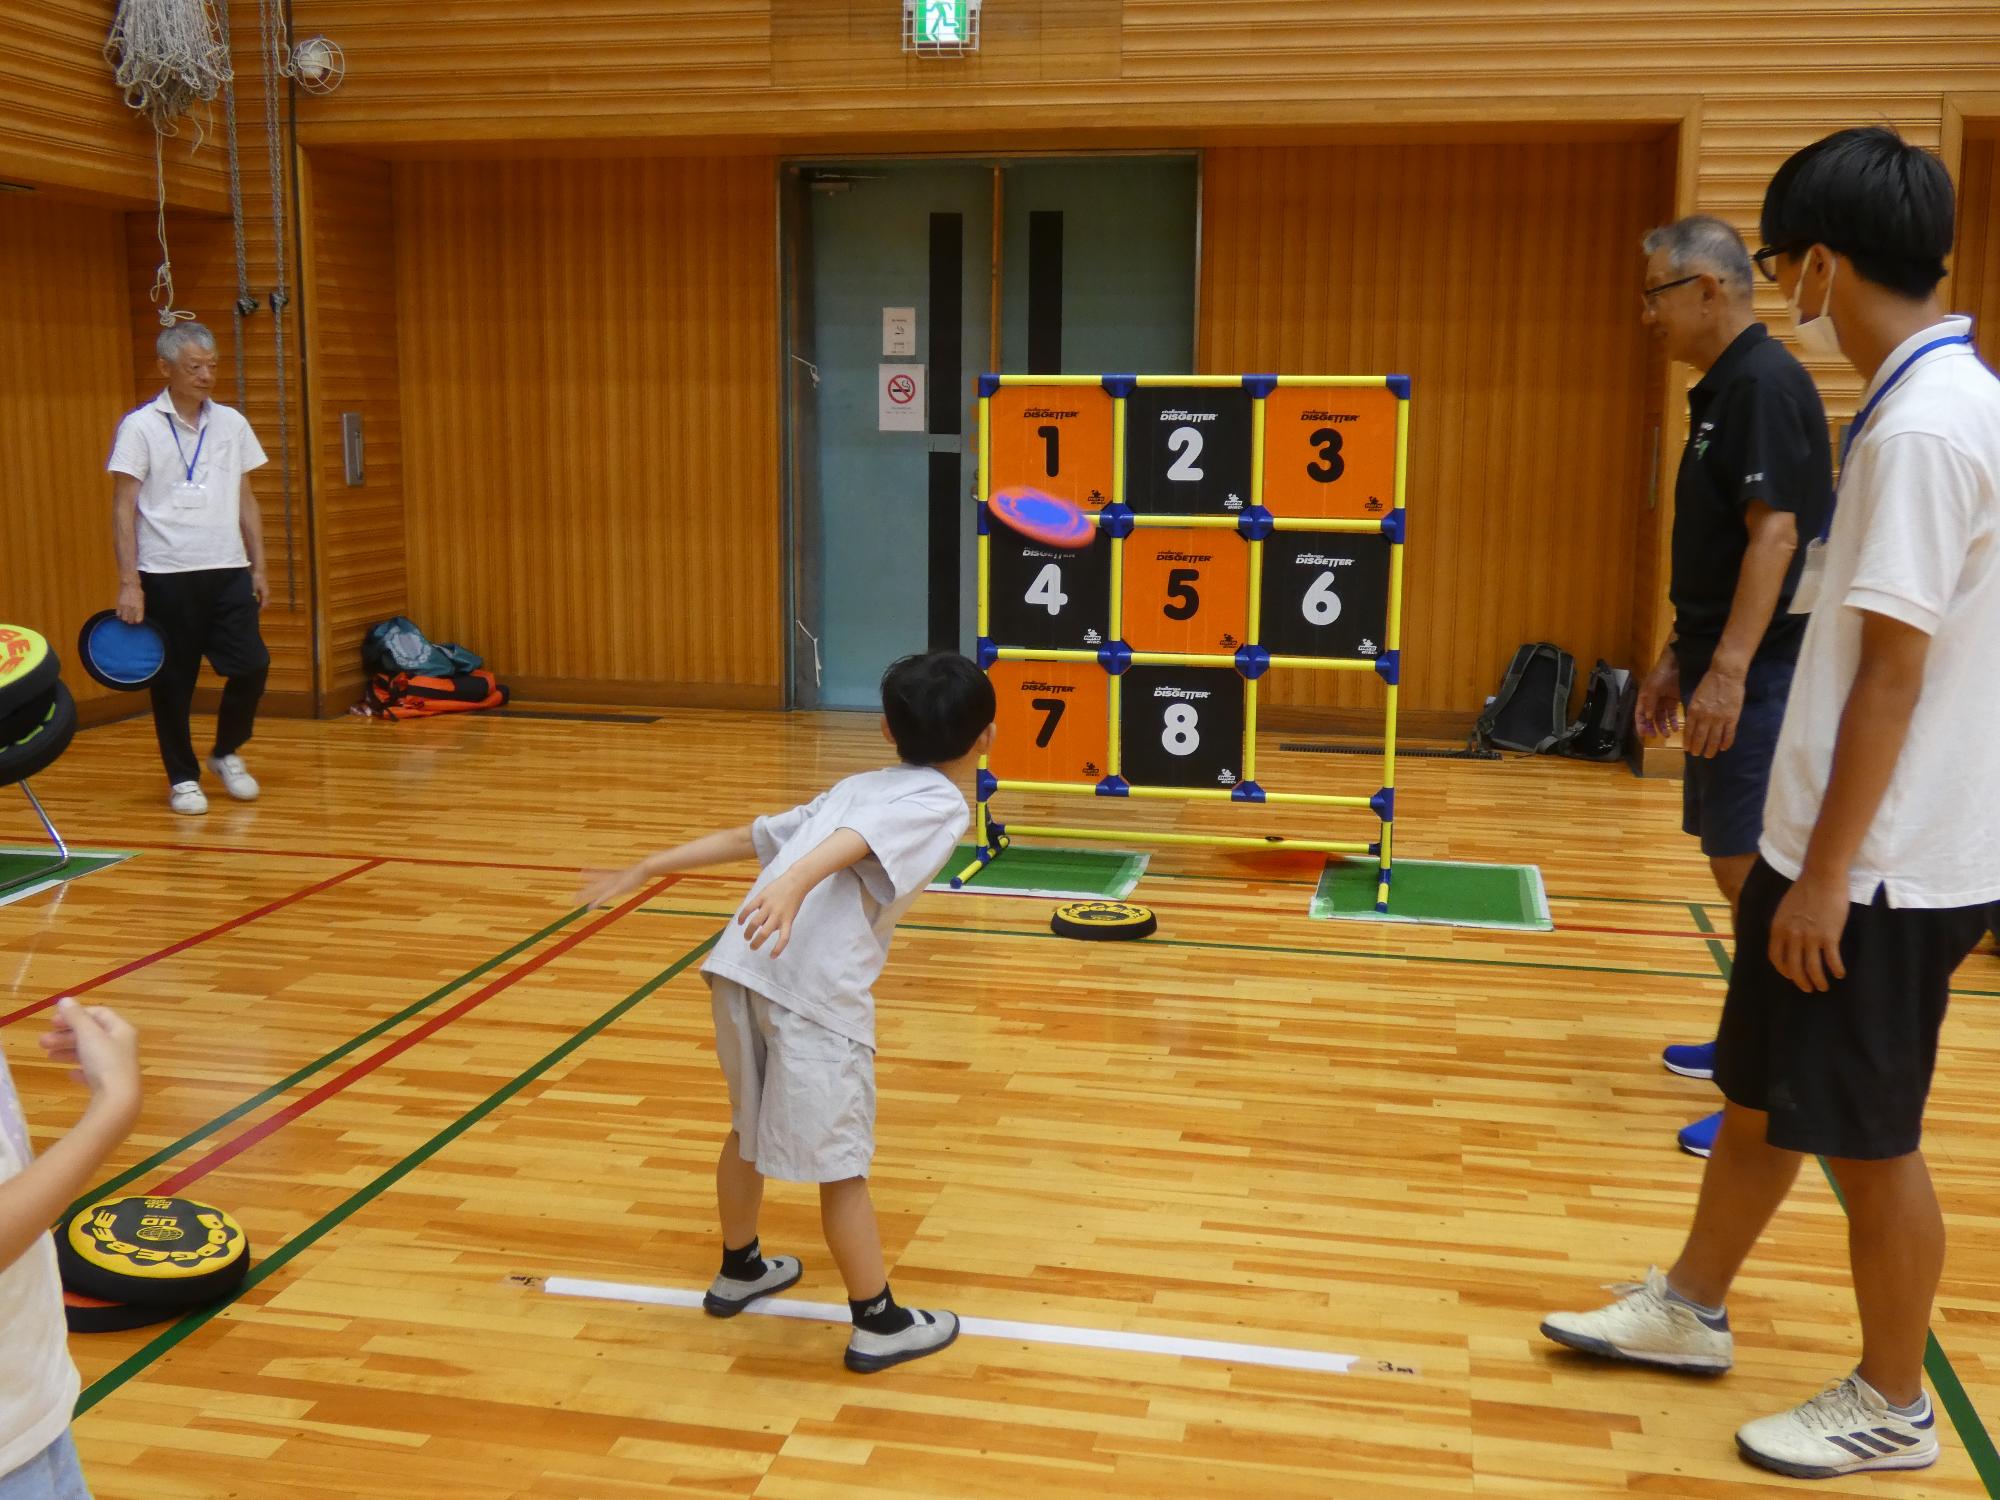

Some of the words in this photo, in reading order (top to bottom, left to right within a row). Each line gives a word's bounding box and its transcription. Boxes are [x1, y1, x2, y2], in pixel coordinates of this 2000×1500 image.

[1024, 411, 1078, 420] DISGETTER
[1160, 413, 1216, 423] DISGETTER
[1300, 414, 1359, 424] DISGETTER
[1037, 426, 1059, 477] 1
[1166, 426, 1204, 481] 2
[1306, 427, 1345, 483] 3
[1156, 554, 1212, 563] DISGETTER
[1295, 557, 1353, 567] DISGETTER
[1024, 563, 1069, 616] 4
[1163, 568, 1200, 621] 5
[1302, 571, 1342, 626] 6
[1021, 684, 1075, 694] DISGETTER
[1153, 690, 1209, 700] DISGETTER
[1031, 698, 1066, 748] 7
[1161, 703, 1200, 756] 8
[93, 1209, 228, 1262] DODGEBEE
